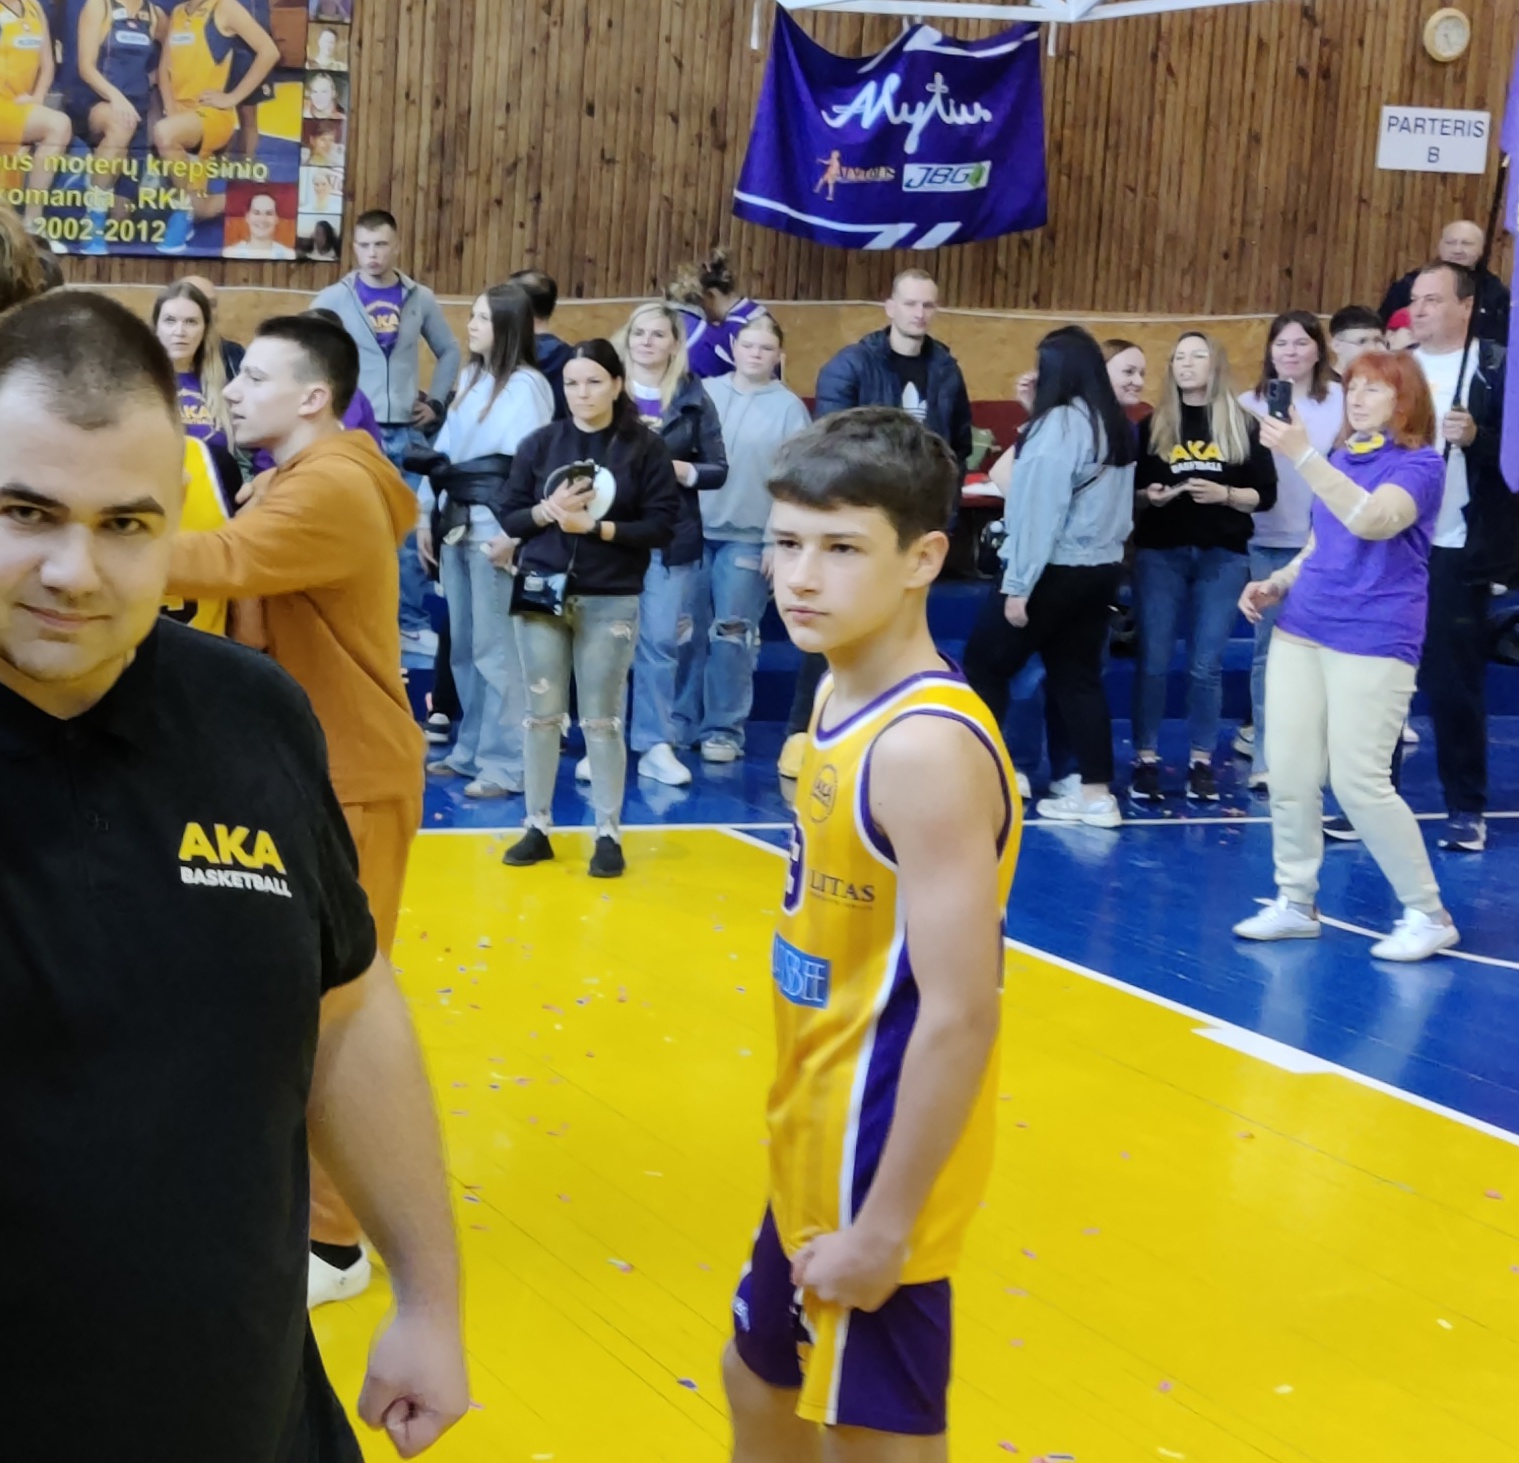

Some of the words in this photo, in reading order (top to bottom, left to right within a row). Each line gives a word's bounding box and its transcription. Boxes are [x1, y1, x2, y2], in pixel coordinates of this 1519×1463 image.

[1387, 115, 1485, 138] PARTERIS
[44, 154, 138, 182] moterų
[1427, 146, 1440, 163] B
[33, 217, 166, 244] 2002-2012
[1169, 440, 1227, 465] AKA
[178, 821, 288, 876] AKA
[179, 865, 293, 899] BASKETBALL
